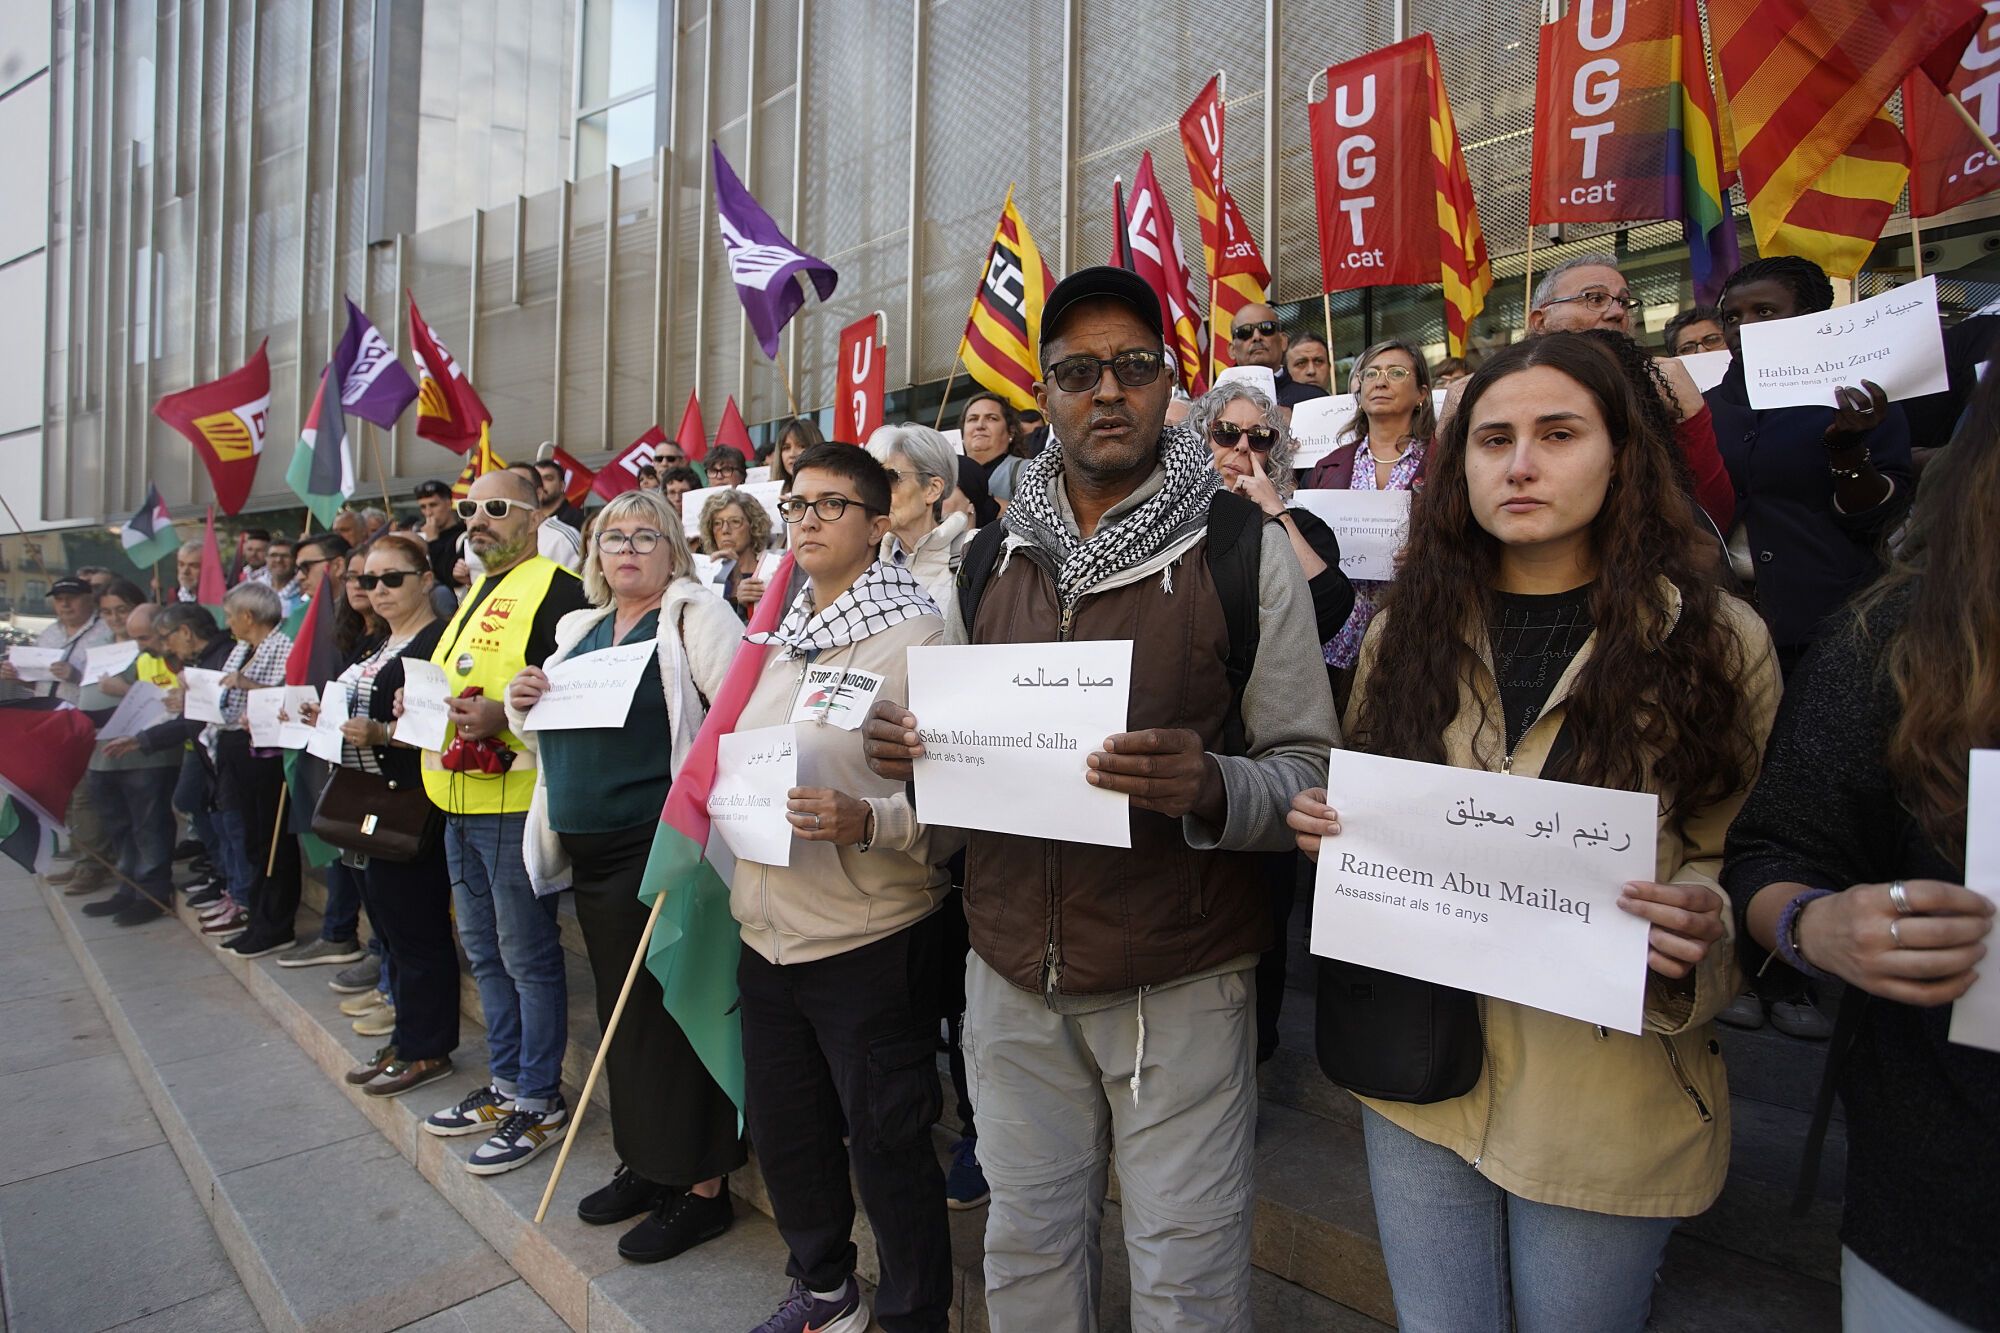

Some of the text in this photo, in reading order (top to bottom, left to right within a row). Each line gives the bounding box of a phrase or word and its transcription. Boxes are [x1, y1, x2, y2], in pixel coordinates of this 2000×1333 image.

[1570, 0, 1626, 180] UGT
[1335, 74, 1377, 247] UGT
[1559, 180, 1617, 206] .cat
[1340, 248, 1385, 269] .cat
[1861, 310, 1880, 329] ابو
[1885, 300, 1924, 317] حبيبة
[1758, 346, 1891, 379] Habiba Abu Zarqa
[1758, 381, 1777, 389] Mort
[1779, 381, 1800, 389] quan
[1801, 378, 1823, 386] tenia
[1831, 375, 1848, 384] any
[491, 598, 516, 613] UGT
[808, 670, 878, 693] STOP GNOCIDI
[1012, 667, 1114, 692] صبا صالحه
[918, 729, 1078, 750] Saba Mohammed Salha
[924, 750, 985, 767] Mort als 3 anys
[1446, 797, 1631, 852] رنيم ابو معيلق
[1340, 852, 1591, 924] Raneem Abu Mailaq
[1335, 883, 1489, 923] Assassinat als 16 anys
